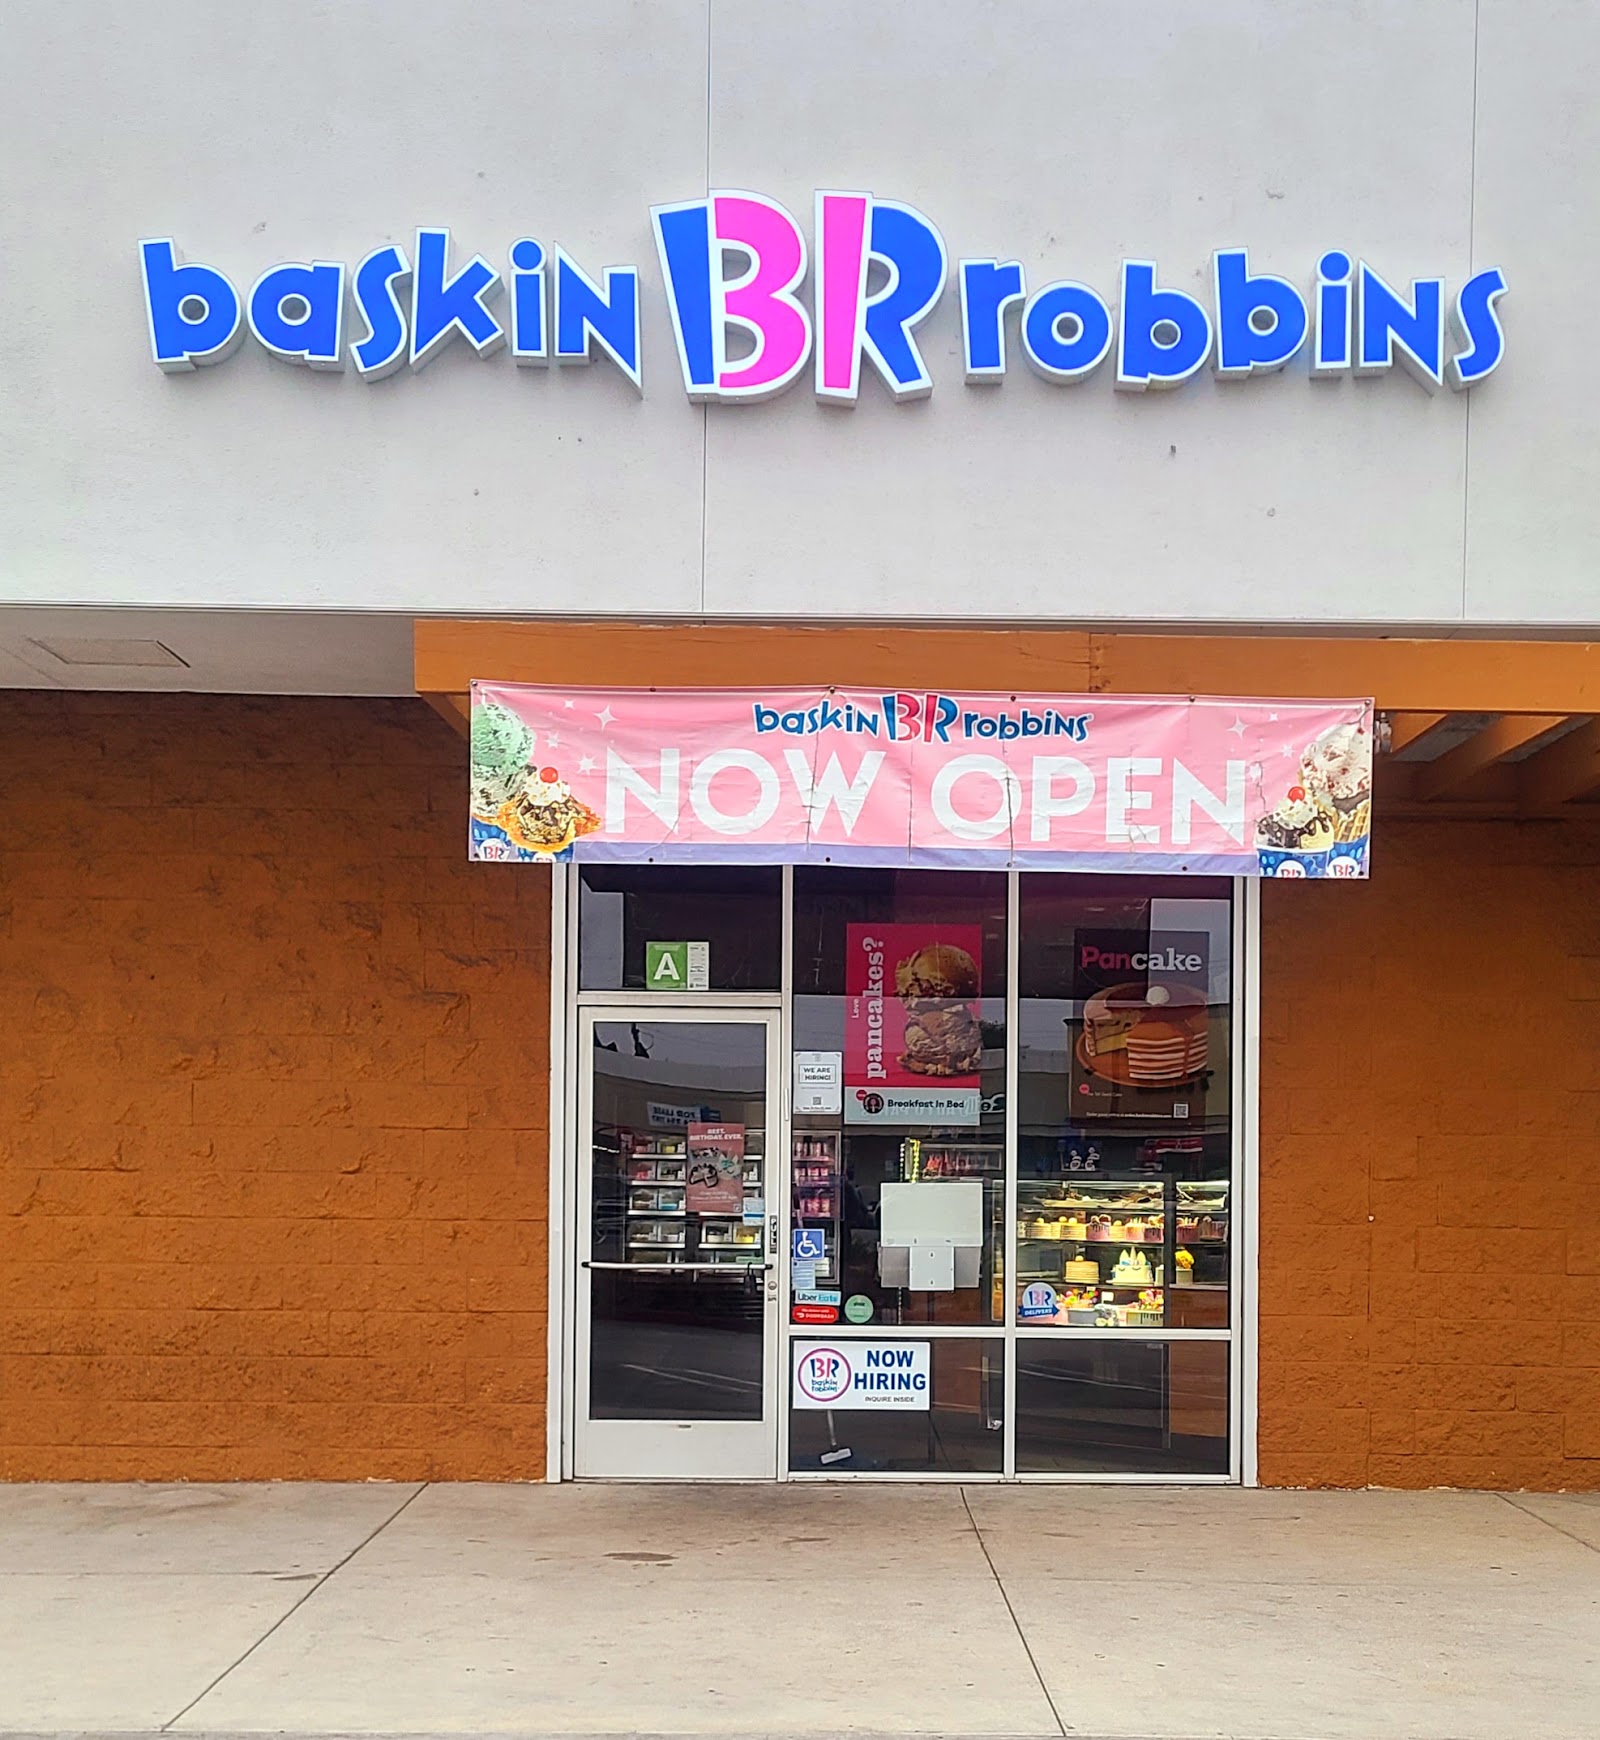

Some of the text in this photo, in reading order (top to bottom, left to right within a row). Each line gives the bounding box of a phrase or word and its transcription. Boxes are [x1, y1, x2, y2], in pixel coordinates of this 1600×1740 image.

[138, 189, 1509, 398] baskin BR robbins
[754, 693, 1089, 743] baskin BR robbins
[605, 748, 1246, 846] NOW OPEN
[653, 952, 681, 980] A
[1082, 947, 1203, 972] Pancake
[863, 936, 886, 1079] pancakes?
[887, 1099, 934, 1108] Breakfast
[946, 1099, 964, 1108] Bed
[797, 1293, 818, 1301] Uber
[1028, 1290, 1052, 1306] BR
[810, 1357, 839, 1378] BR
[866, 1350, 914, 1367] NOW
[854, 1373, 926, 1390] HIRING
